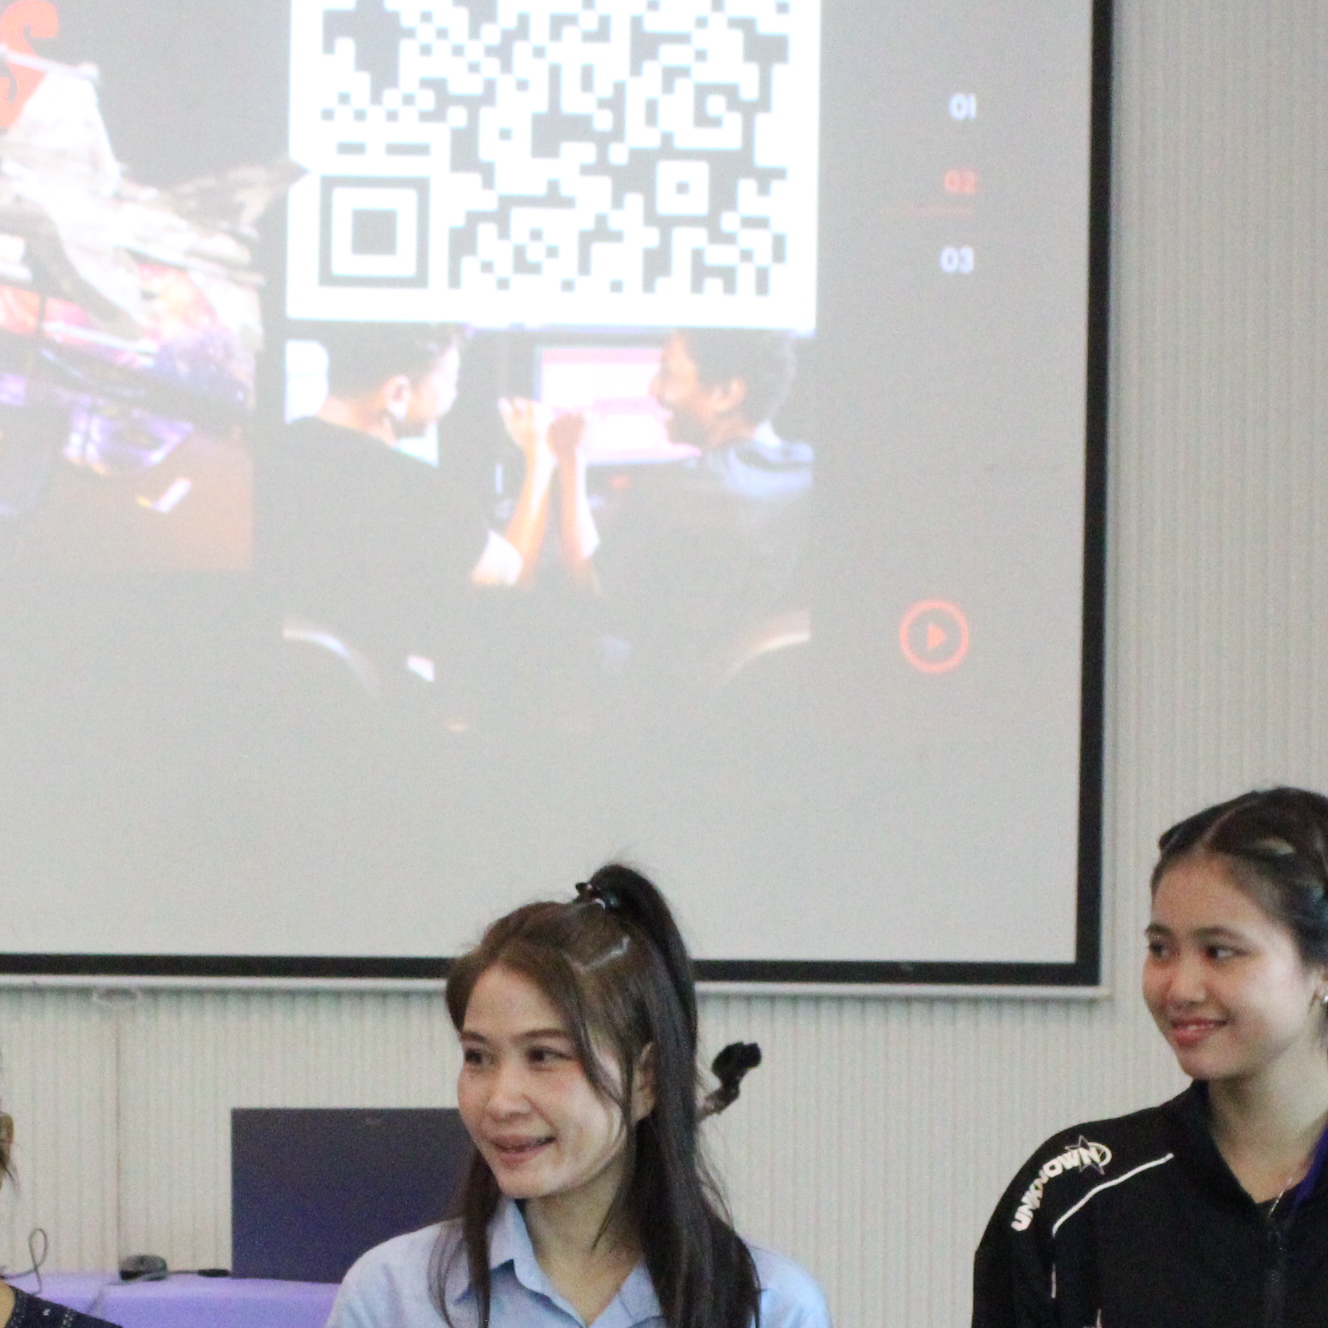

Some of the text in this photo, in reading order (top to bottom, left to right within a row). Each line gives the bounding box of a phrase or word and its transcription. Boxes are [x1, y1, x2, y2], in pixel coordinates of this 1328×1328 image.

[948, 93, 977, 121] 01
[940, 246, 975, 274] 03
[1010, 1146, 1103, 1232] UNKNOWN
